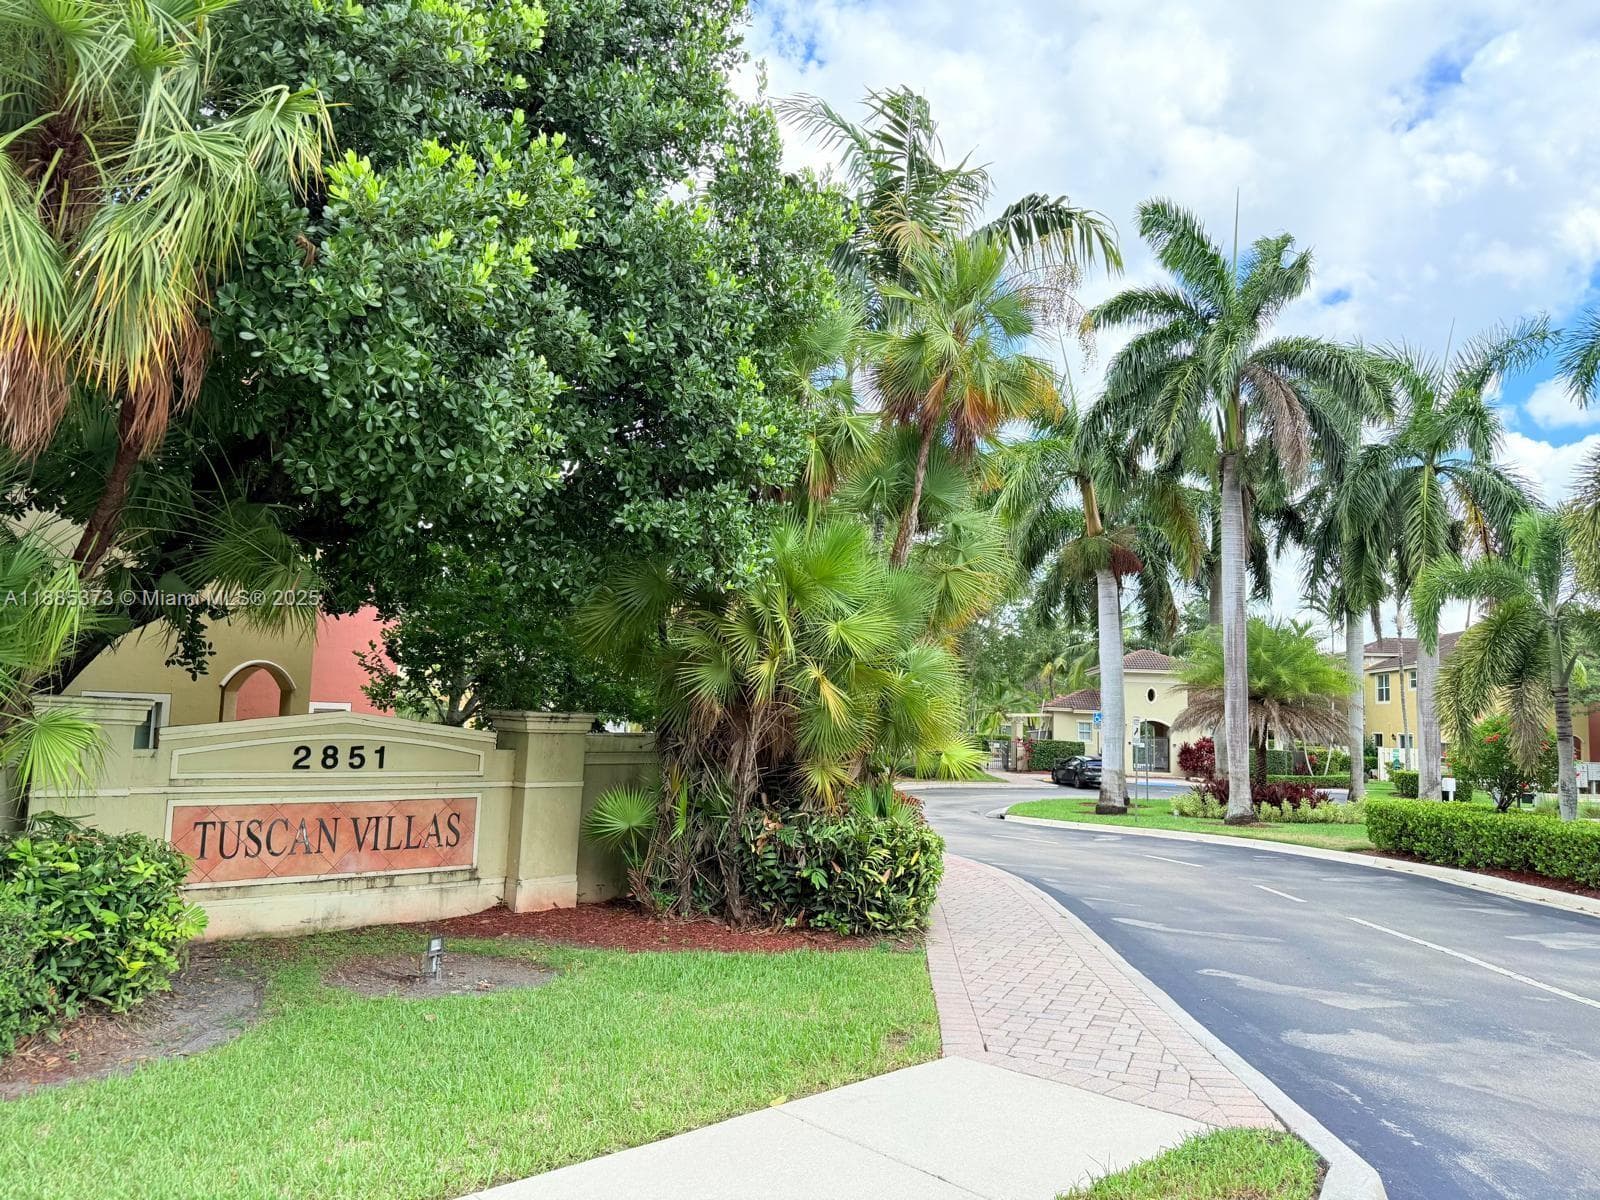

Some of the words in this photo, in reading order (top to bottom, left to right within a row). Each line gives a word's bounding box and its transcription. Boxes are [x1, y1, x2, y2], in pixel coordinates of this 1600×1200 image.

[292, 745, 386, 770] 2851
[193, 816, 340, 860] TUSCAN
[349, 811, 461, 853] VILLAS
